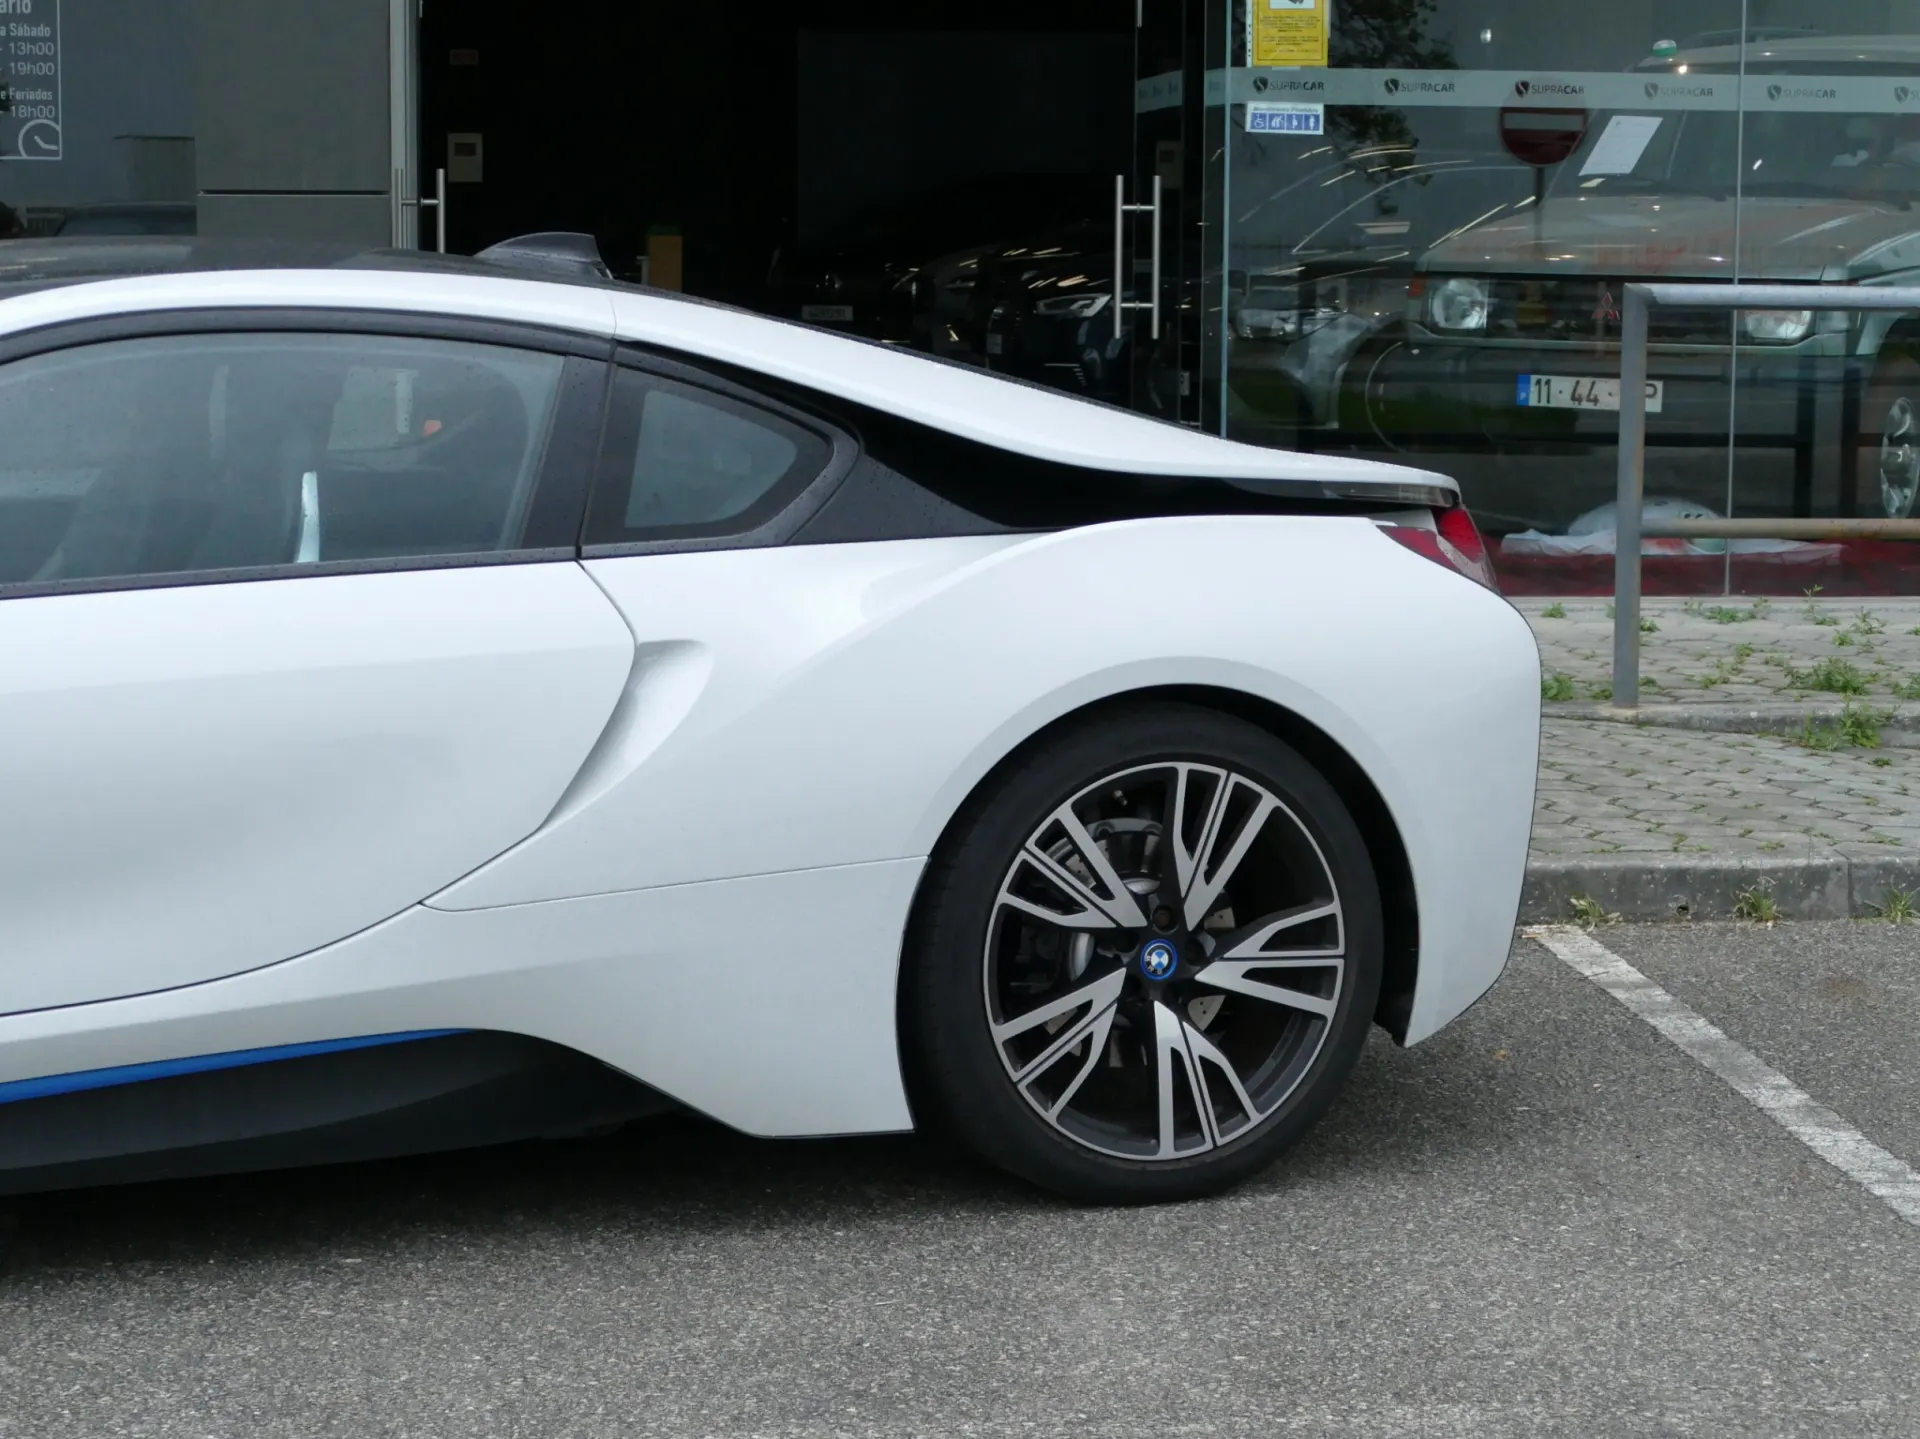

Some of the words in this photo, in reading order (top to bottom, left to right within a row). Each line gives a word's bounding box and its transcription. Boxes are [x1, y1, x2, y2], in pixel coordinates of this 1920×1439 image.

[9, 23, 51, 37] Sábado
[9, 42, 55, 55] 13h00
[9, 62, 55, 75] 19h00
[1270, 80, 1324, 91] SUPRACAR
[1400, 82, 1455, 93] SUPRACAR
[1531, 84, 1585, 95] SUPRACAR
[1660, 86, 1713, 97] SUPRACAR
[9, 87, 53, 100] Feriados
[1783, 88, 1837, 99] SUPRACAR
[10, 105, 55, 118] 18h00
